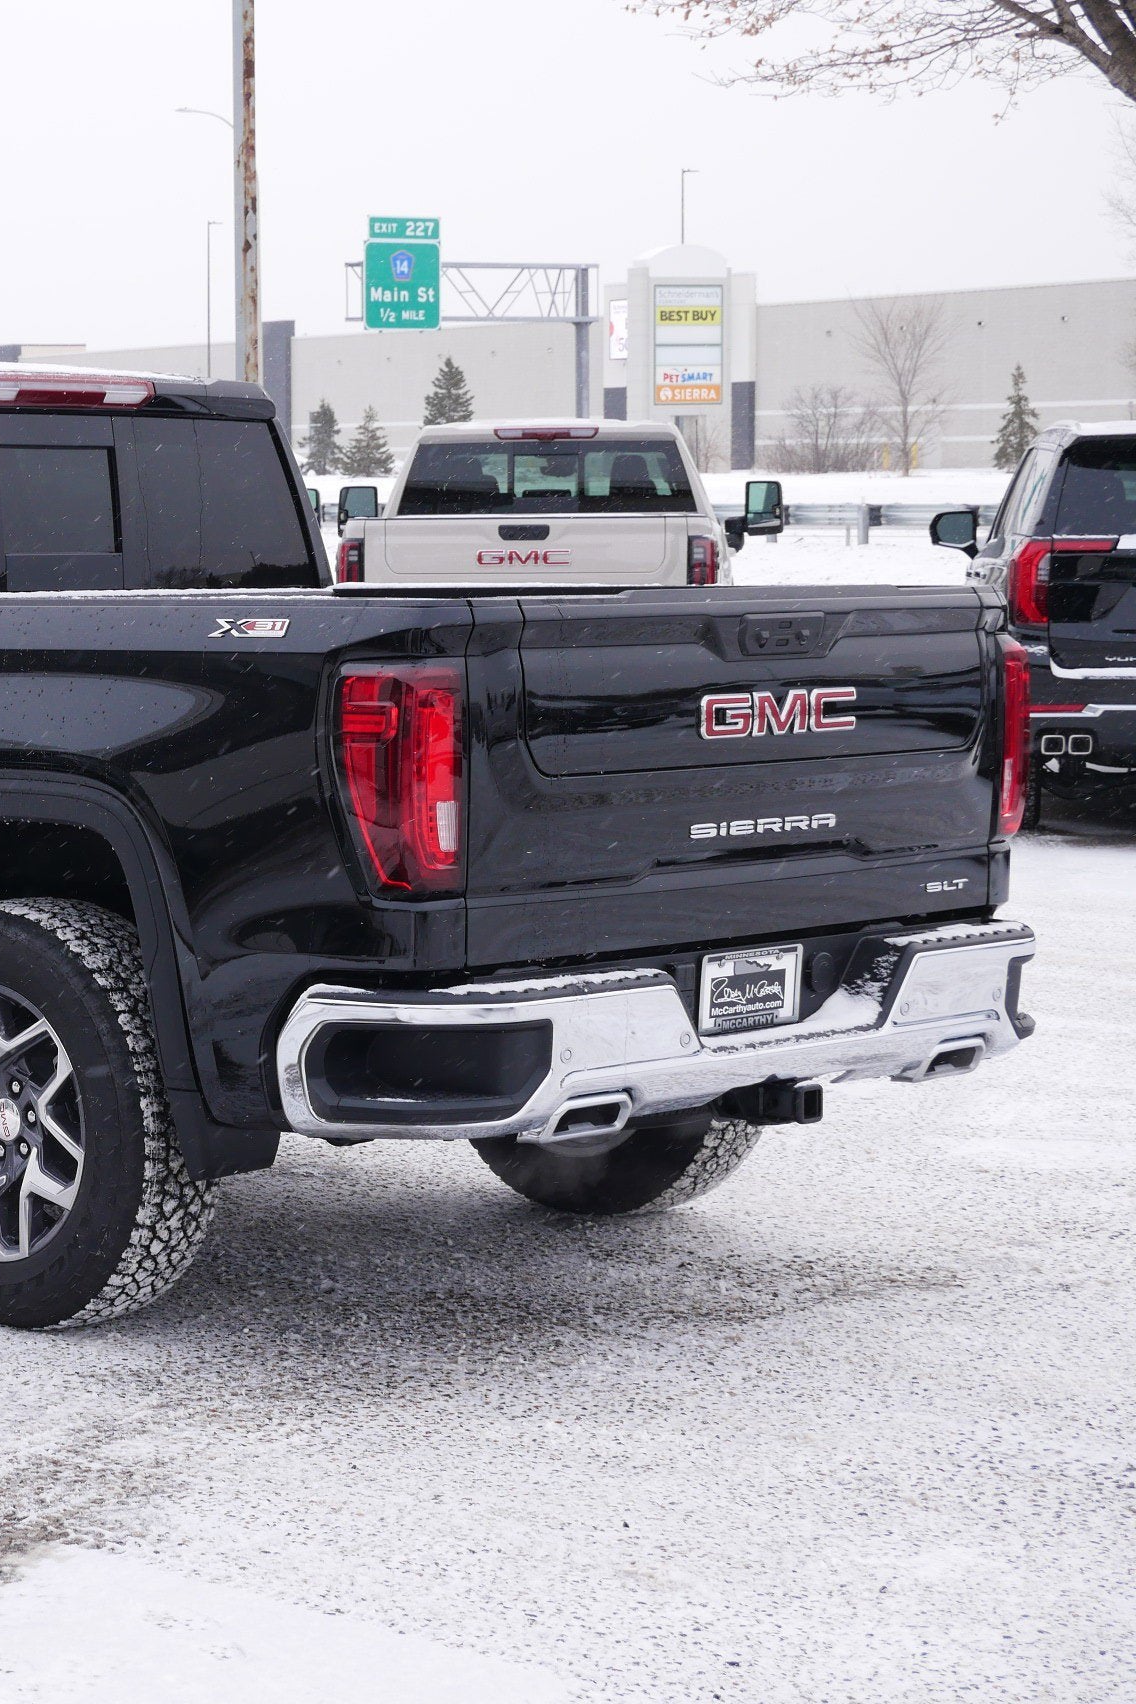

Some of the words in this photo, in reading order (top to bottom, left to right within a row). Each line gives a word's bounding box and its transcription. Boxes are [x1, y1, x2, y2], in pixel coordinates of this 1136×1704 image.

[374, 223, 397, 233] EXIT
[405, 221, 435, 236] 227
[396, 260, 409, 274] 14
[370, 286, 409, 302] Main
[417, 287, 435, 303] St
[401, 310, 425, 320] MILE
[660, 310, 689, 321] BEST
[692, 310, 717, 321] BUY
[674, 388, 716, 400] SIERRA
[476, 549, 571, 566] GMC
[700, 686, 856, 740] GMC
[690, 813, 836, 838] SIERRA
[926, 878, 969, 892] SLT
[725, 949, 780, 960] MINNESOTA
[711, 1000, 782, 1016] McCarthyauto.com
[722, 1014, 774, 1030] MCCARTHY
